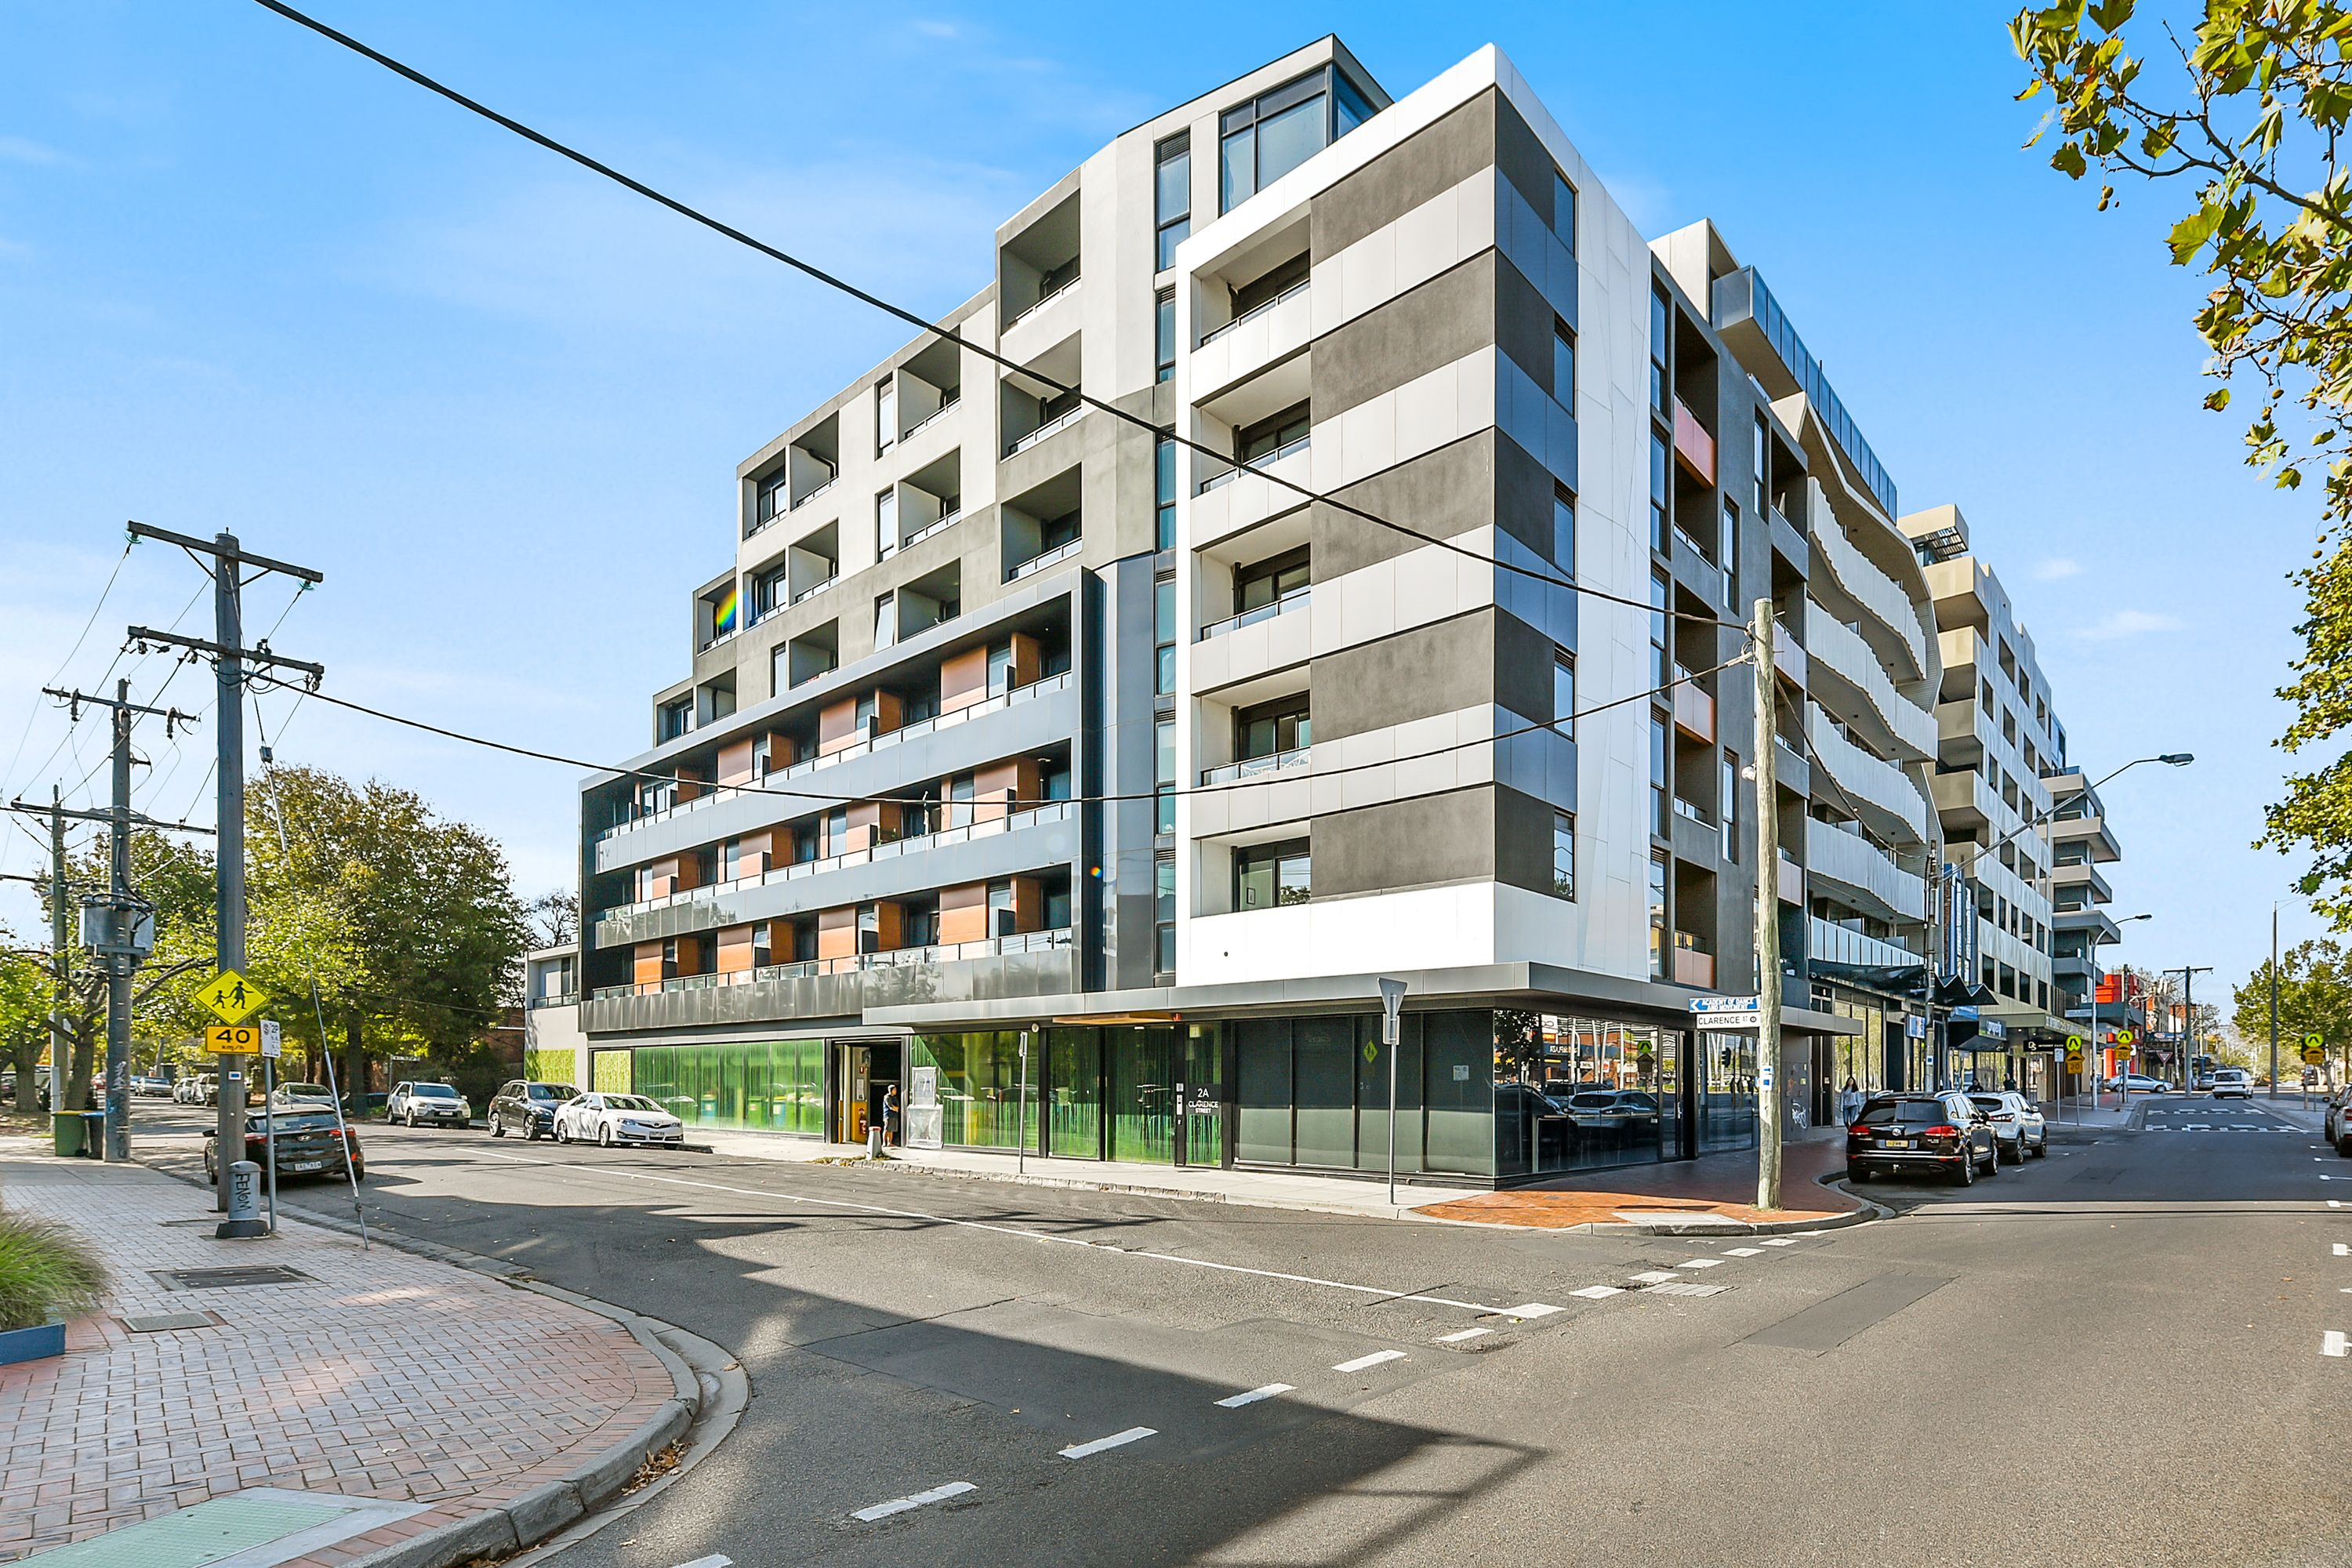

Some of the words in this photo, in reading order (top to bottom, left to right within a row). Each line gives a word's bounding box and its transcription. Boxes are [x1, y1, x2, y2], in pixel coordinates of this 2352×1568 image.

[1698, 1016, 1740, 1025] CLARENCE
[216, 1029, 250, 1044] 40
[1197, 1087, 1210, 1098] 2A
[1188, 1100, 1219, 1109] CLARENCE
